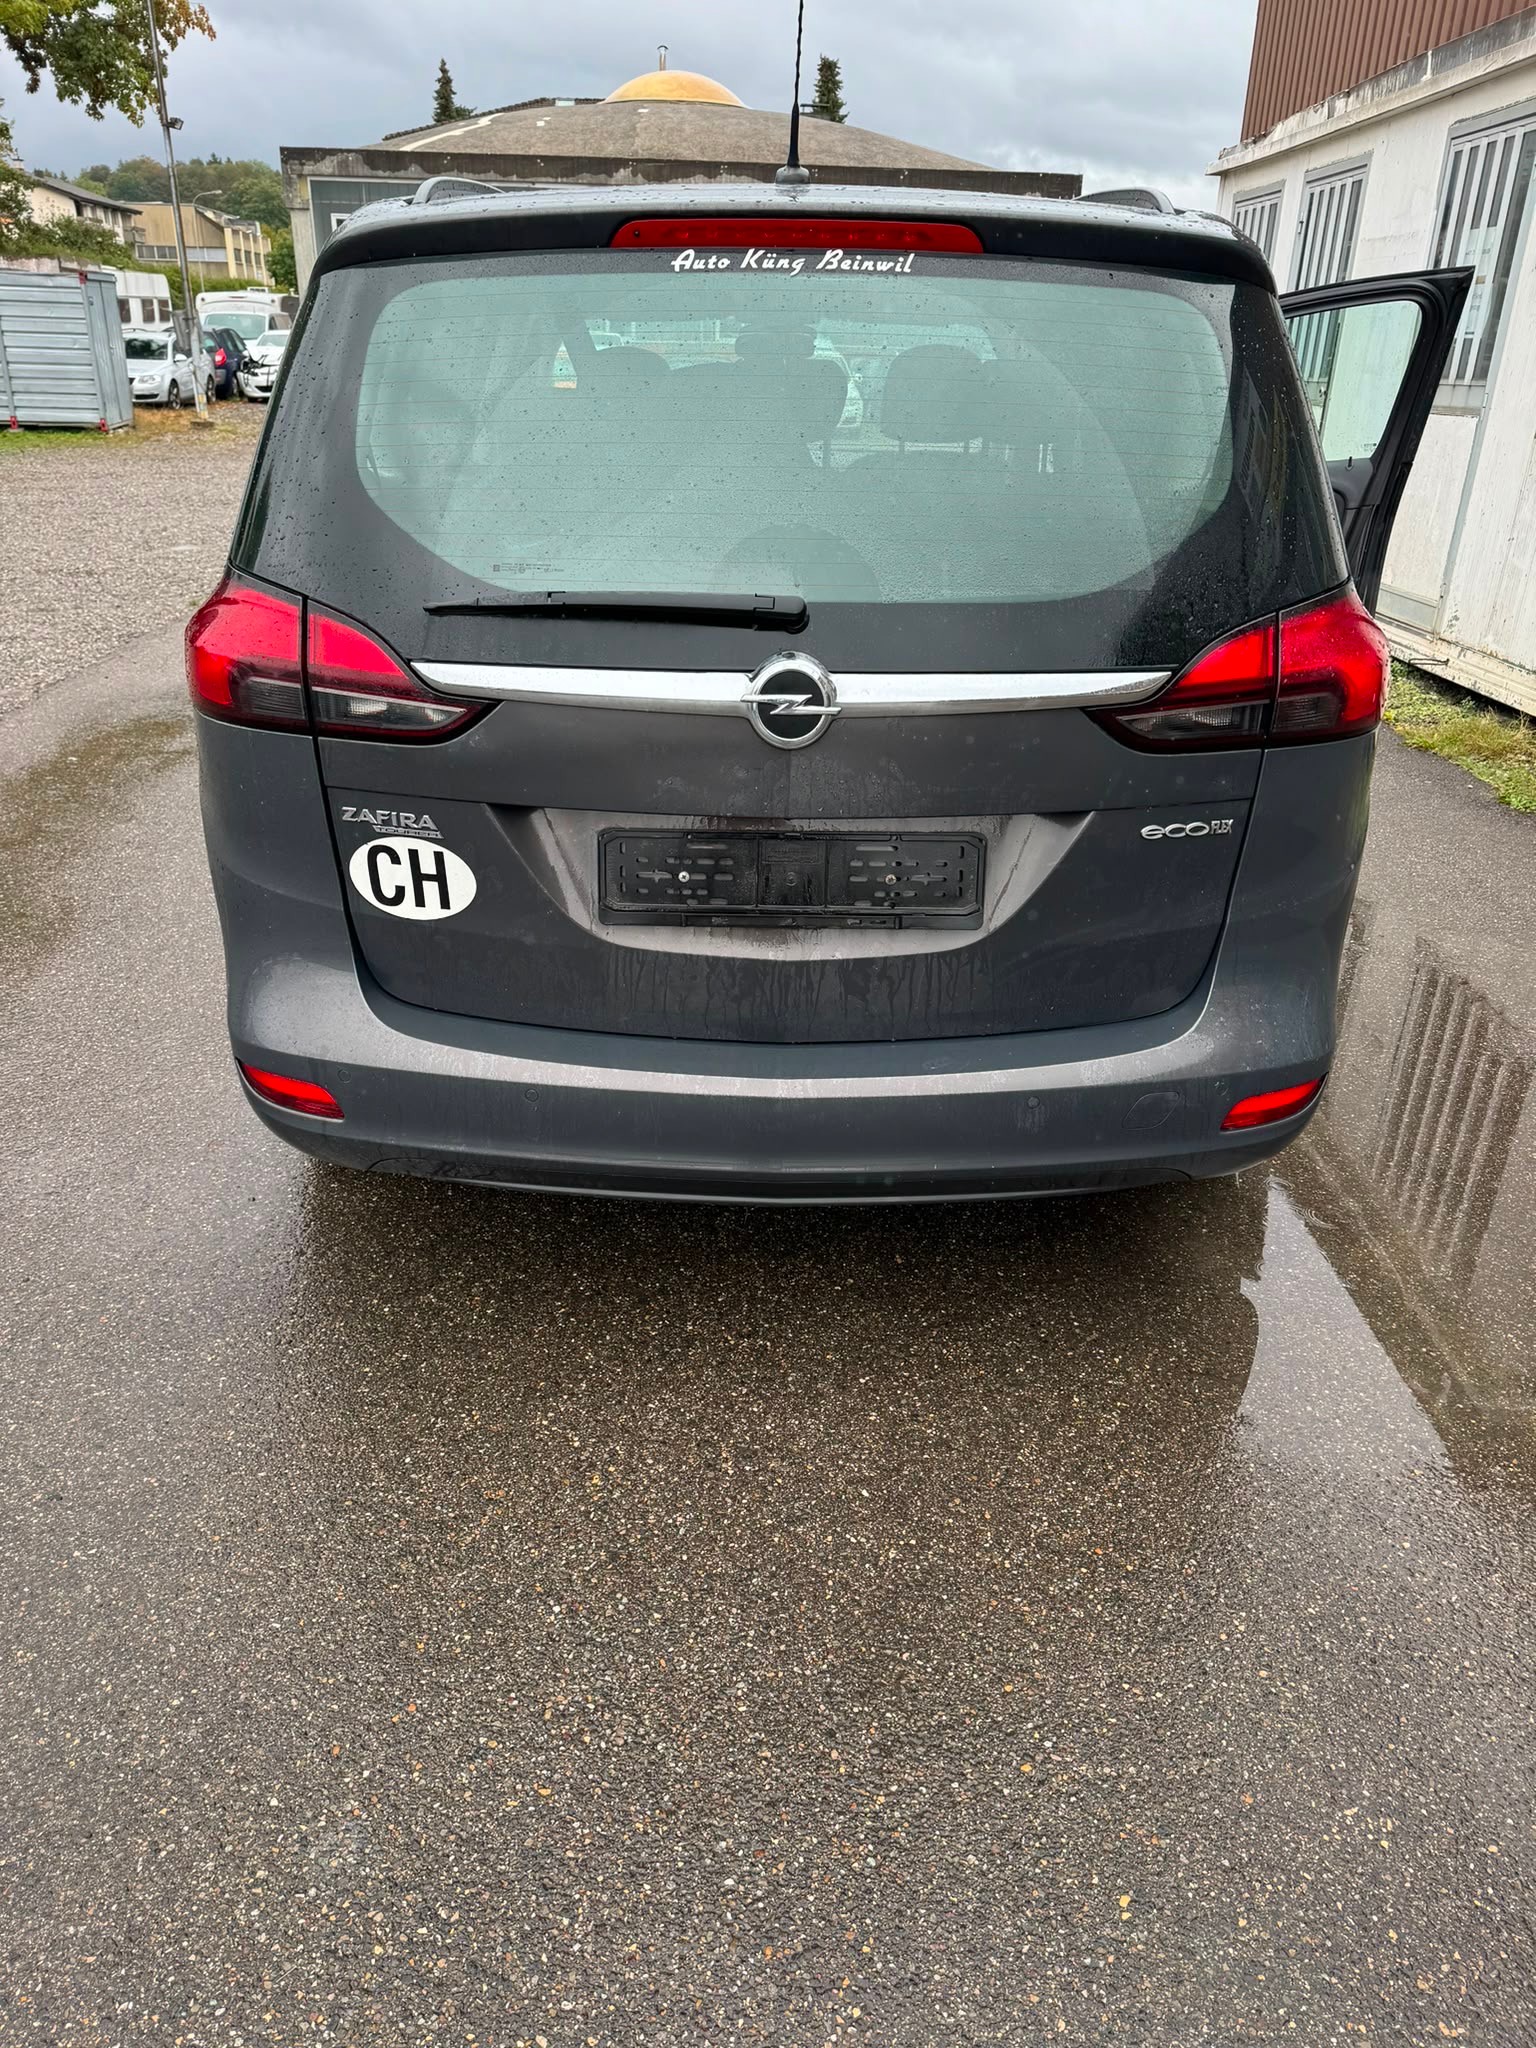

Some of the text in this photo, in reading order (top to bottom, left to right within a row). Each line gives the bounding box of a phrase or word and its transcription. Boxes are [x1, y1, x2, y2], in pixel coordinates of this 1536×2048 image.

[671, 248, 915, 276] Auto Küng Beinwil
[341, 806, 438, 830] ZAFIRA
[367, 844, 451, 910] CH
